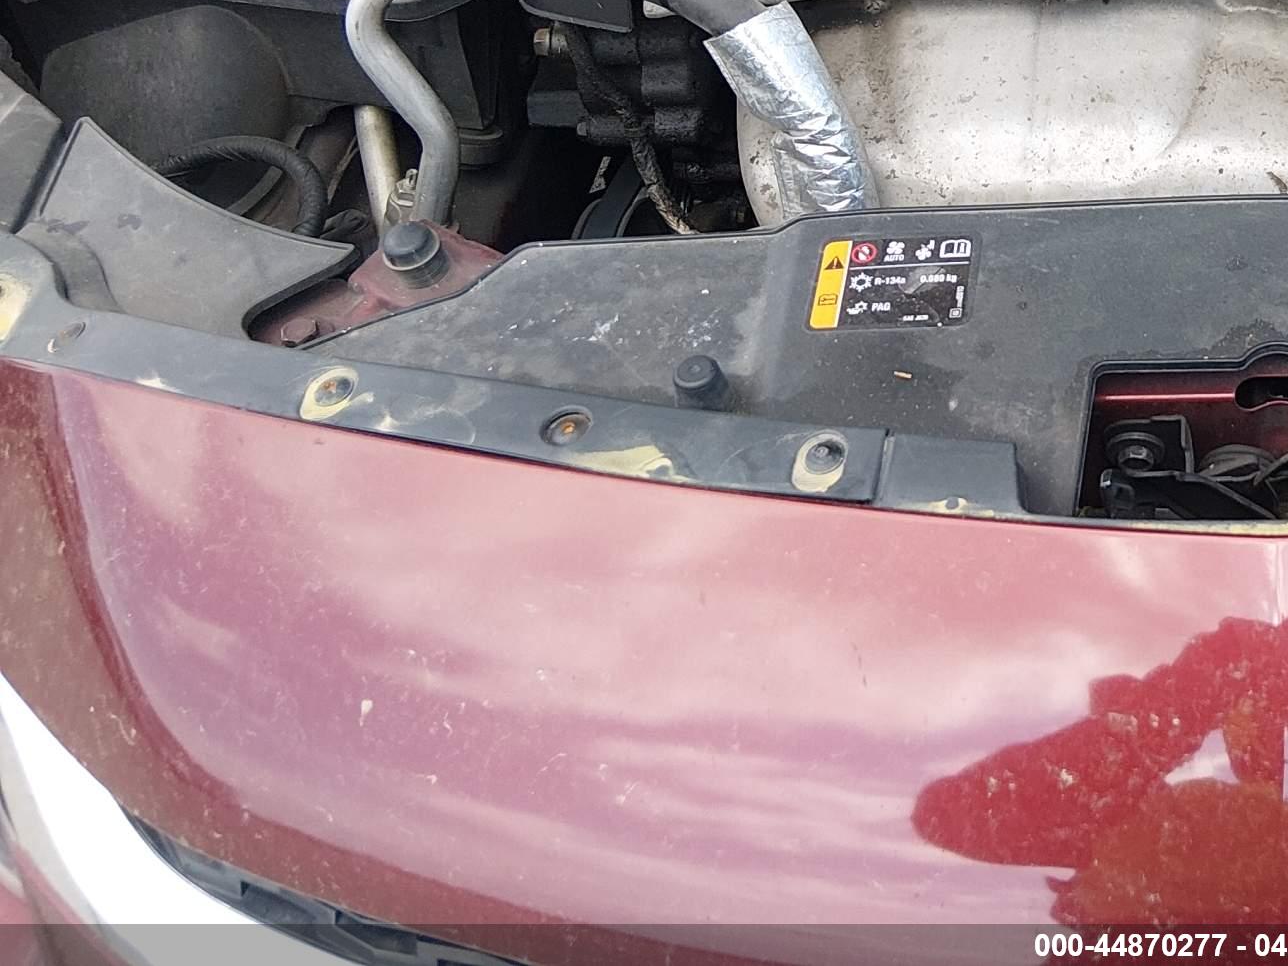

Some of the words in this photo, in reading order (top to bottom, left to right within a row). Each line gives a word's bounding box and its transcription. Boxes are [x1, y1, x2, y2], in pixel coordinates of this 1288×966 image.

[883, 253, 905, 262] AUTO
[873, 276, 906, 286] R-134a
[870, 301, 891, 312] PAG
